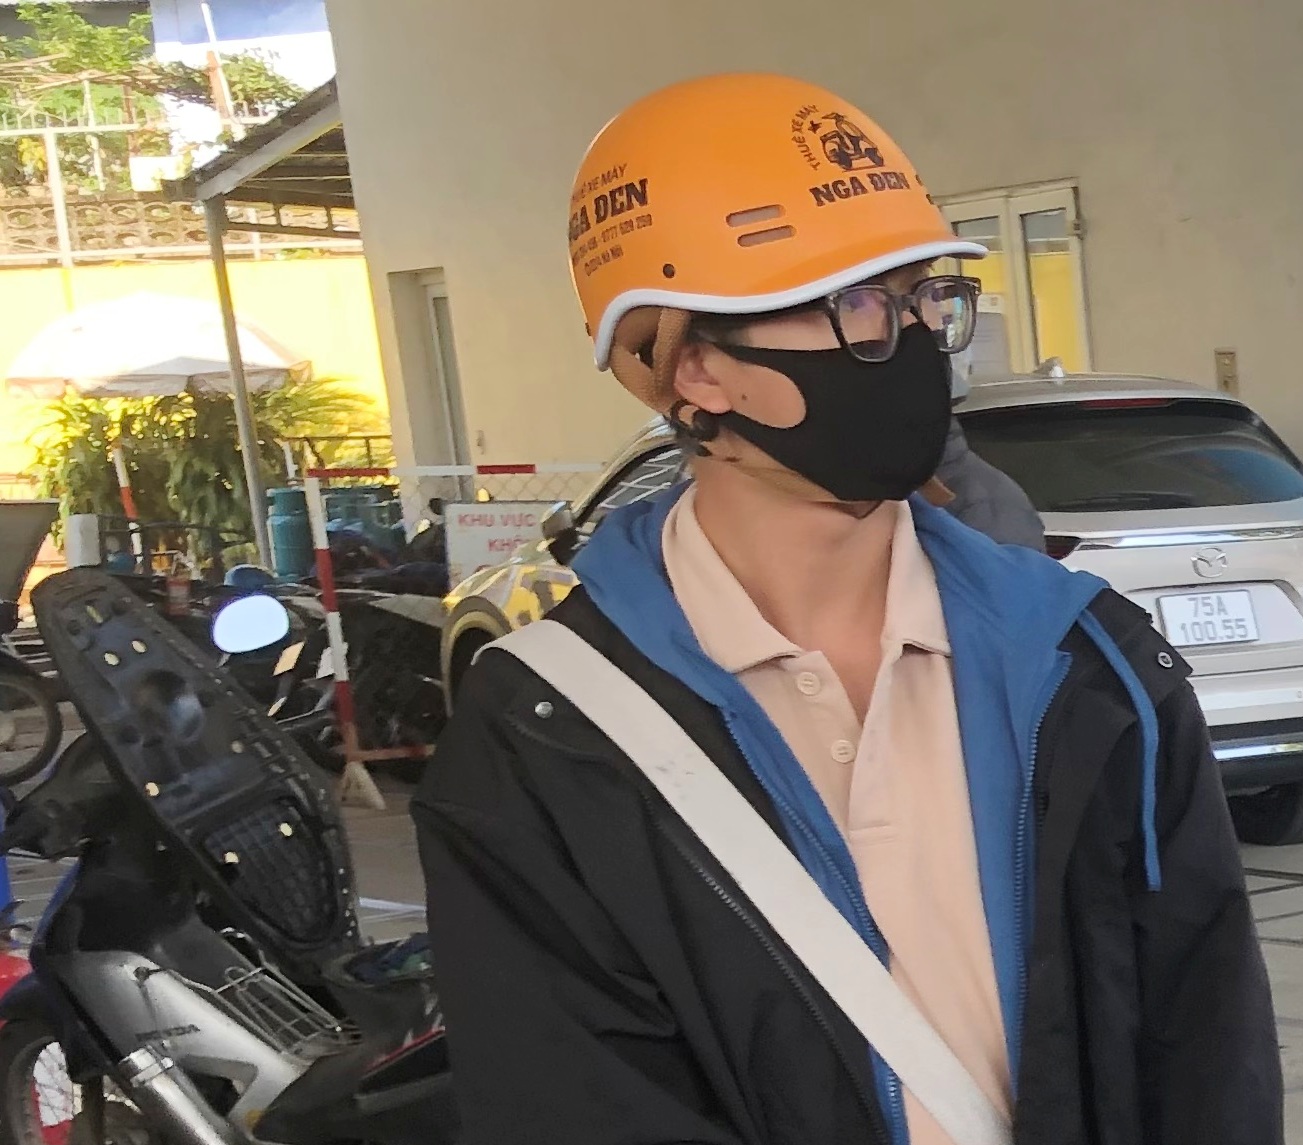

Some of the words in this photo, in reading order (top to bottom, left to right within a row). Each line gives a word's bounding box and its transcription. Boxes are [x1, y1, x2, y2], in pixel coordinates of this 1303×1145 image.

[809, 176, 868, 207] NGA
[866, 172, 910, 191] ĐEN
[568, 204, 591, 241] GA
[593, 178, 648, 224] ĐEN
[458, 513, 495, 527] KHU
[1187, 596, 1228, 617] 75A
[1180, 618, 1248, 643] 100.55
